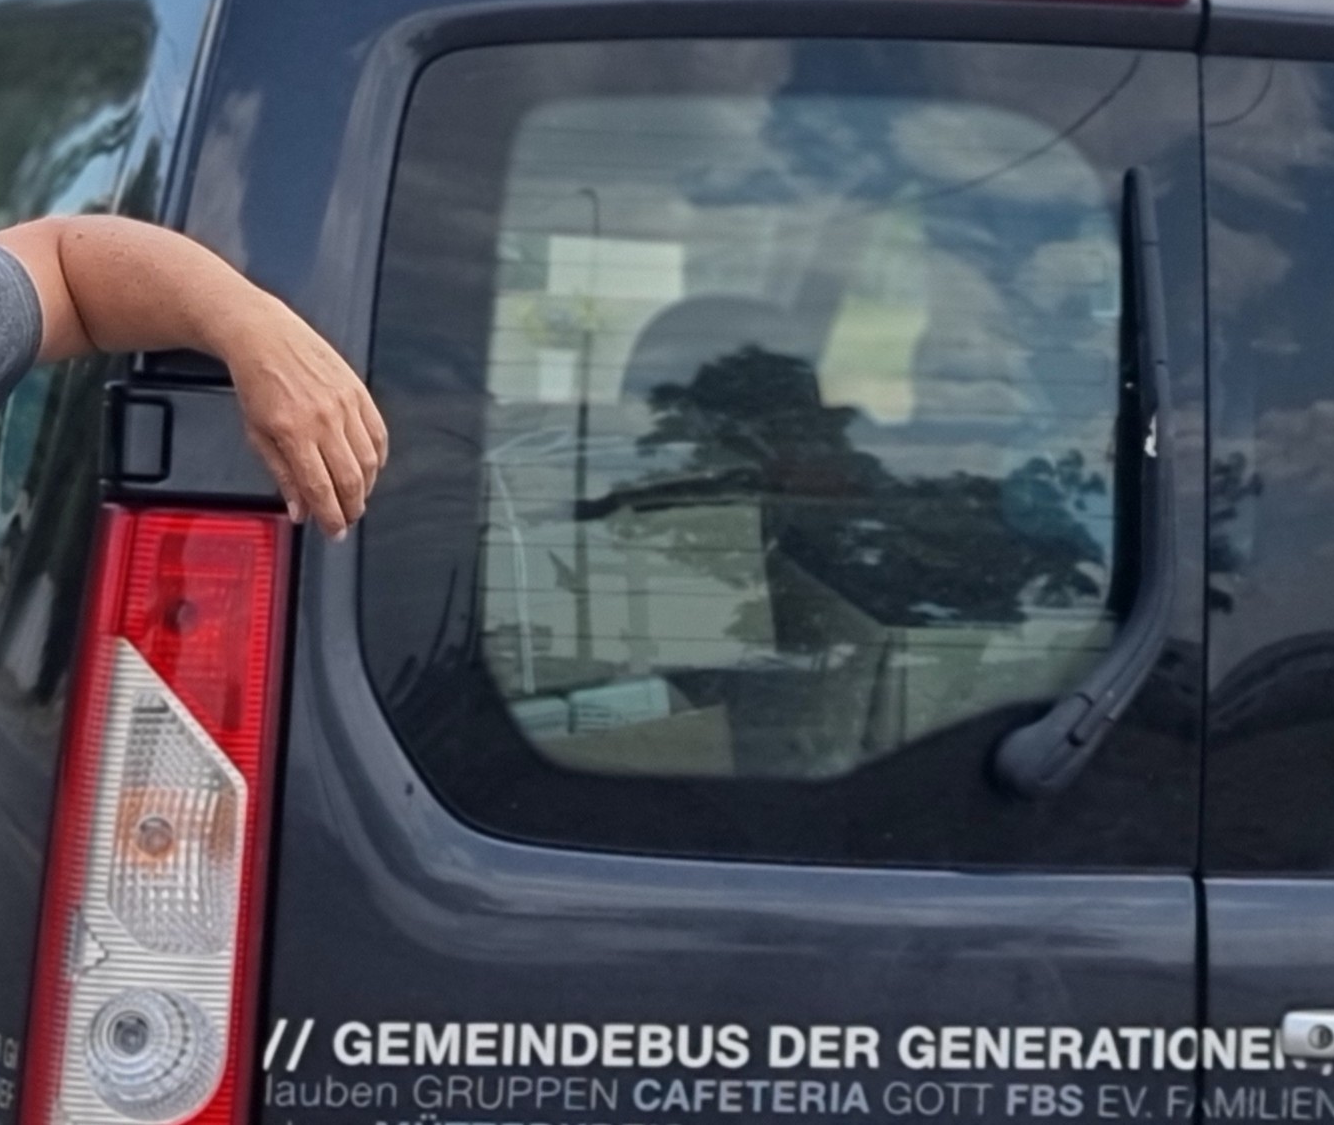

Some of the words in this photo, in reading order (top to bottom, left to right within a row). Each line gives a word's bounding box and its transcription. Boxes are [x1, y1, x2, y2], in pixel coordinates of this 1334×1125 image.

[332, 1020, 750, 1069] GEMEINDEBUS
[768, 1024, 880, 1069] DER
[412, 1074, 619, 1111] GRUPPEN
[632, 1078, 870, 1114] CAFETERIA
[882, 1081, 994, 1116] GOTT
[1005, 1083, 1085, 1117] FBS
[1097, 1084, 1152, 1118] EV.
